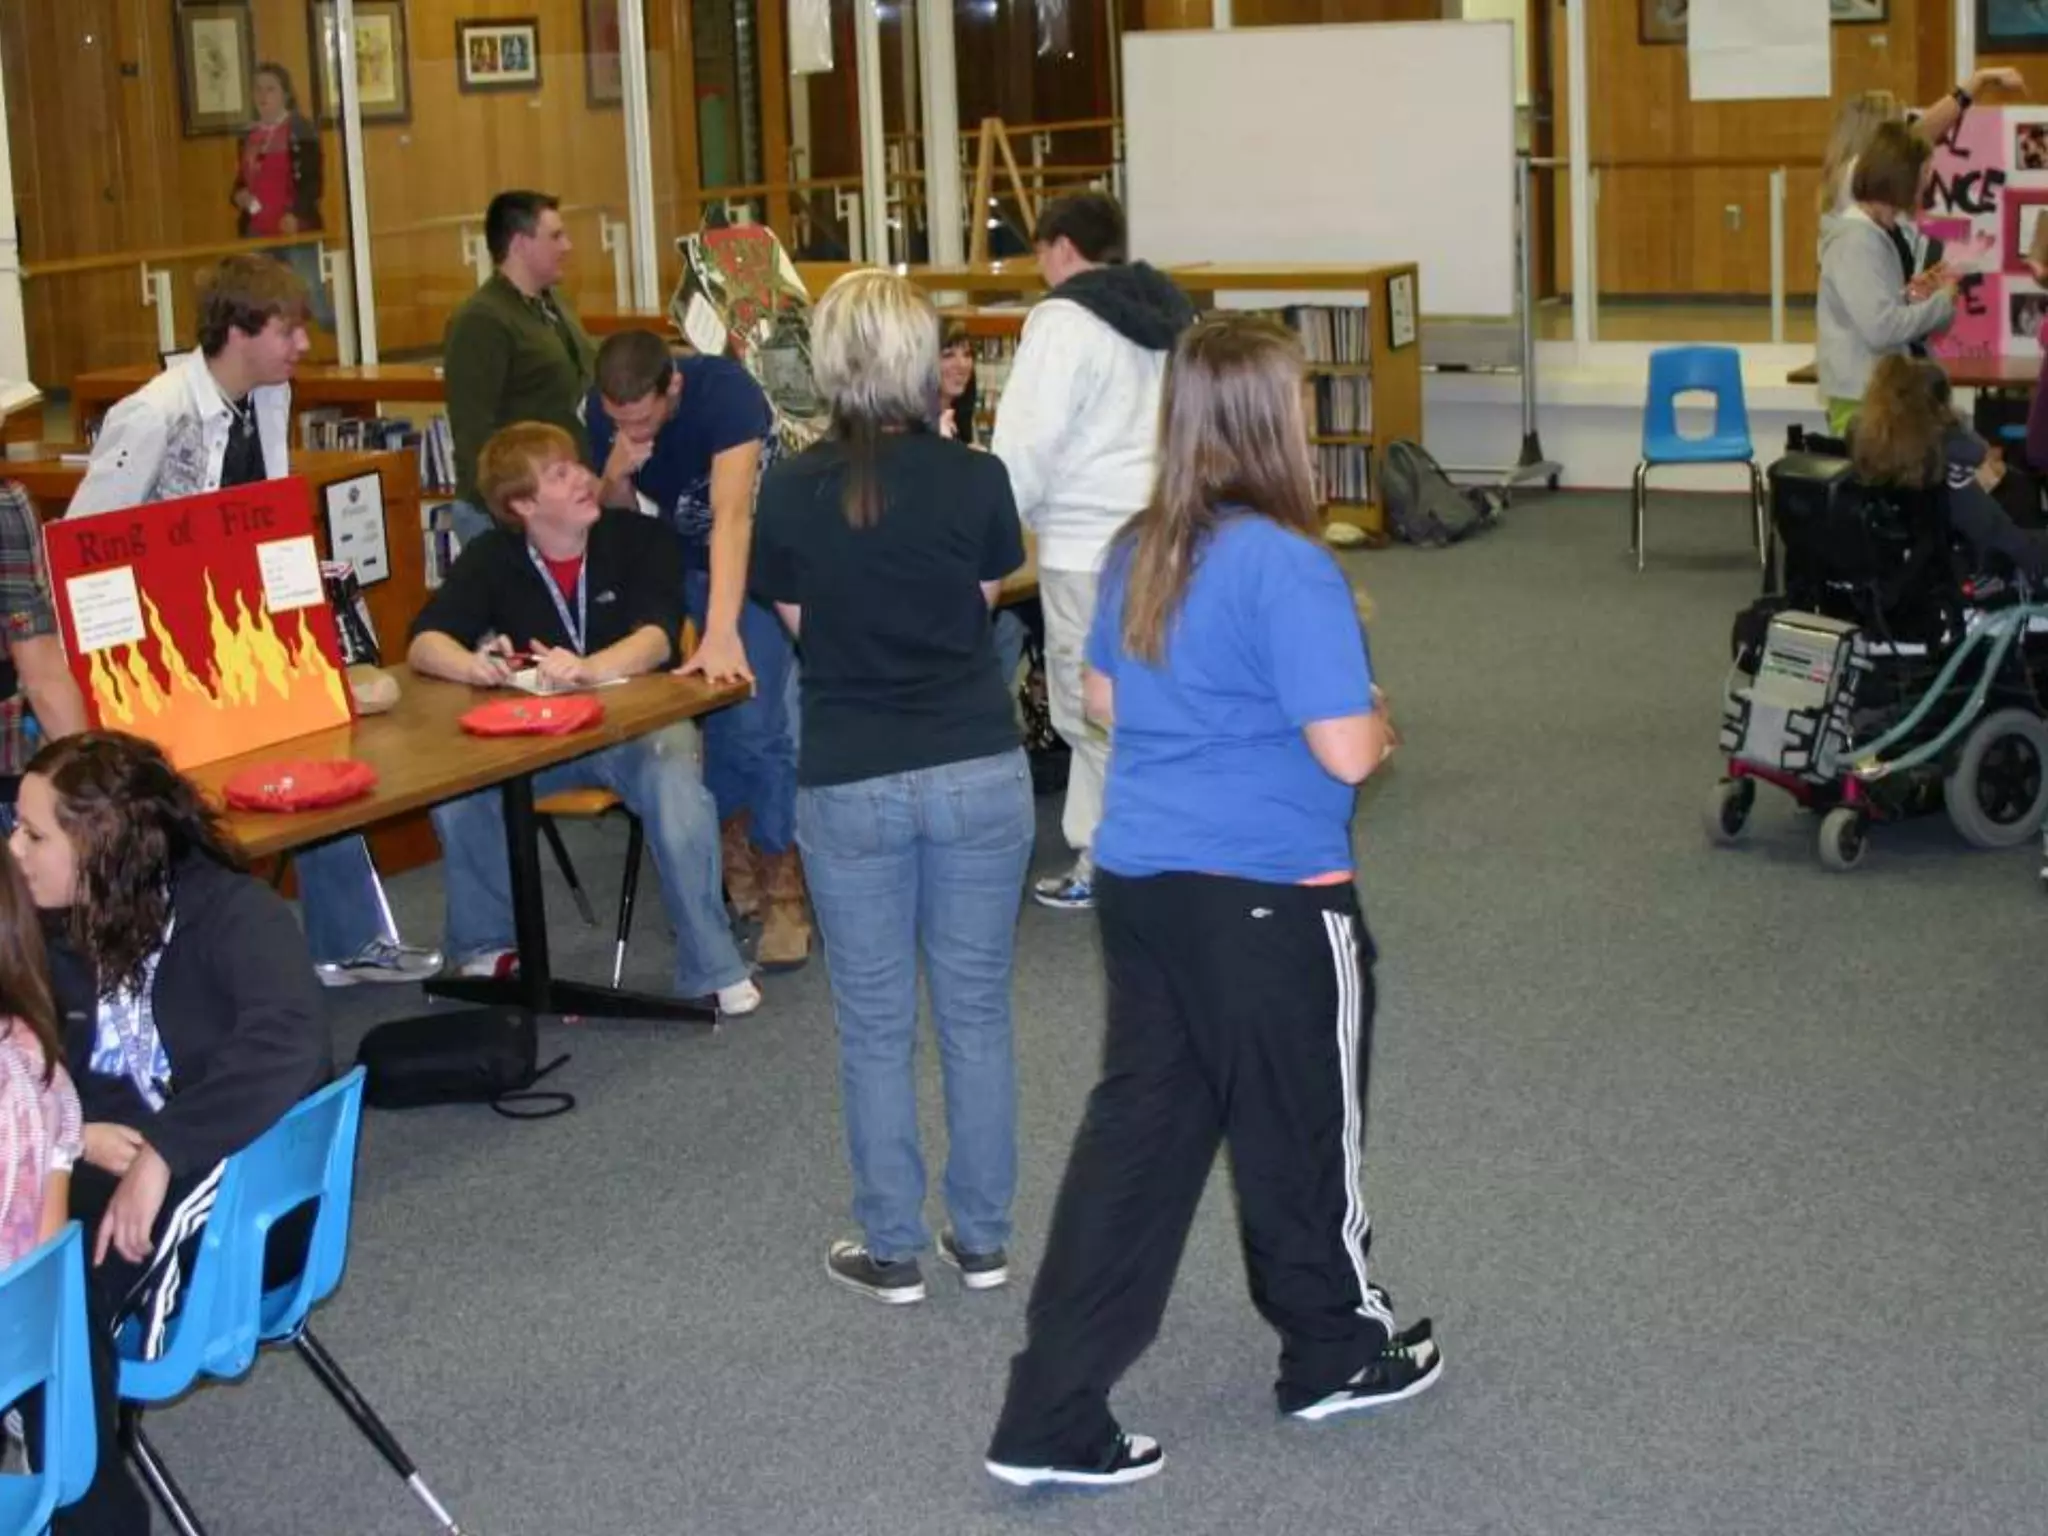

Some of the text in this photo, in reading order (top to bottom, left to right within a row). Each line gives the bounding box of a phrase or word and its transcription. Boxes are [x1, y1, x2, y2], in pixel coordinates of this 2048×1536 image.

[76, 502, 276, 567] Ring of Fire
